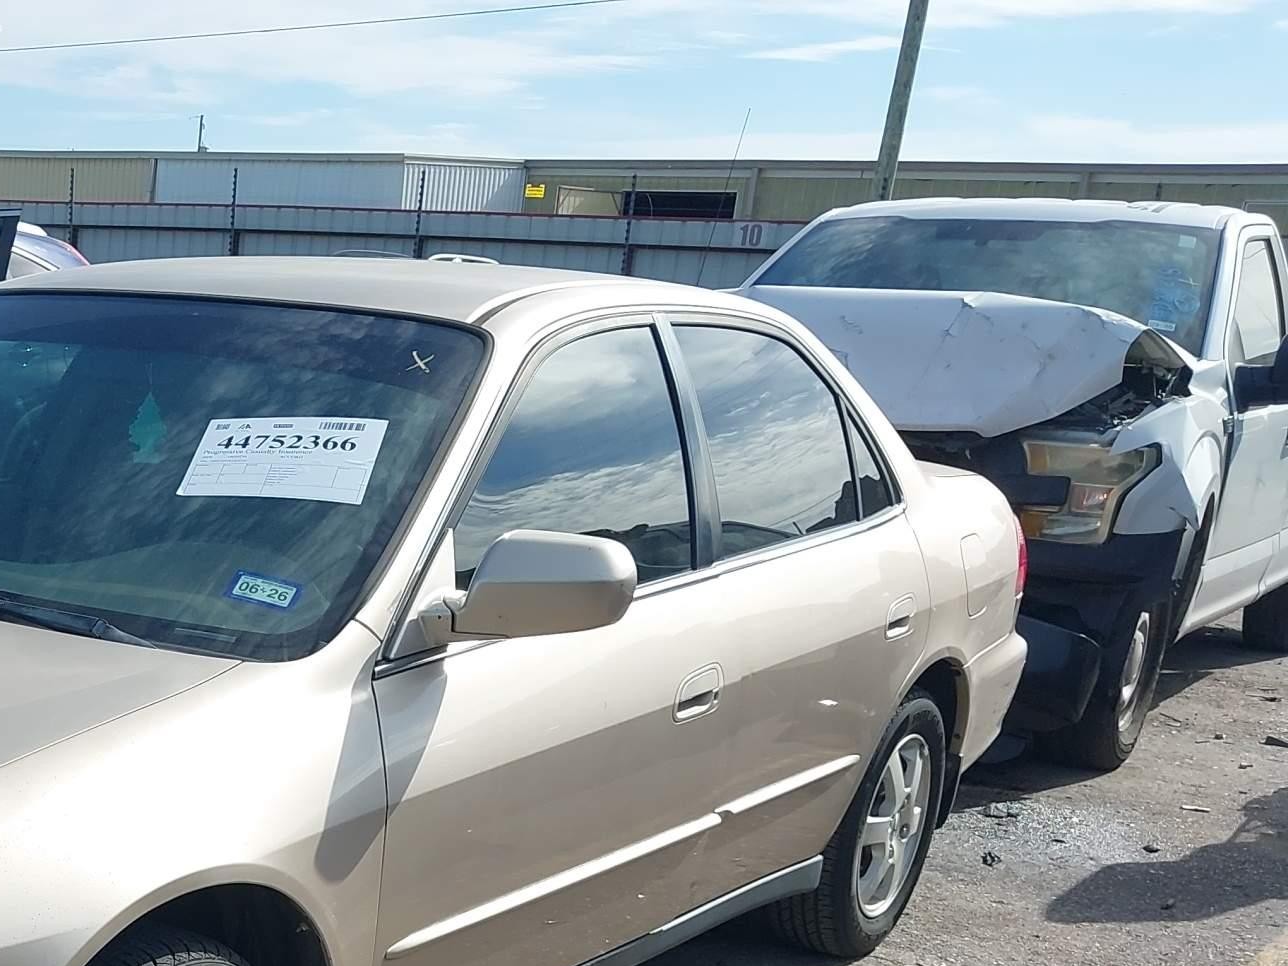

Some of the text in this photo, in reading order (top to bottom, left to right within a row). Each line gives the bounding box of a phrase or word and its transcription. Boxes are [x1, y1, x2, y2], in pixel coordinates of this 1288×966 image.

[740, 224, 762, 246] 10
[216, 435, 359, 451] 44752366
[238, 581, 289, 602] 06 26
